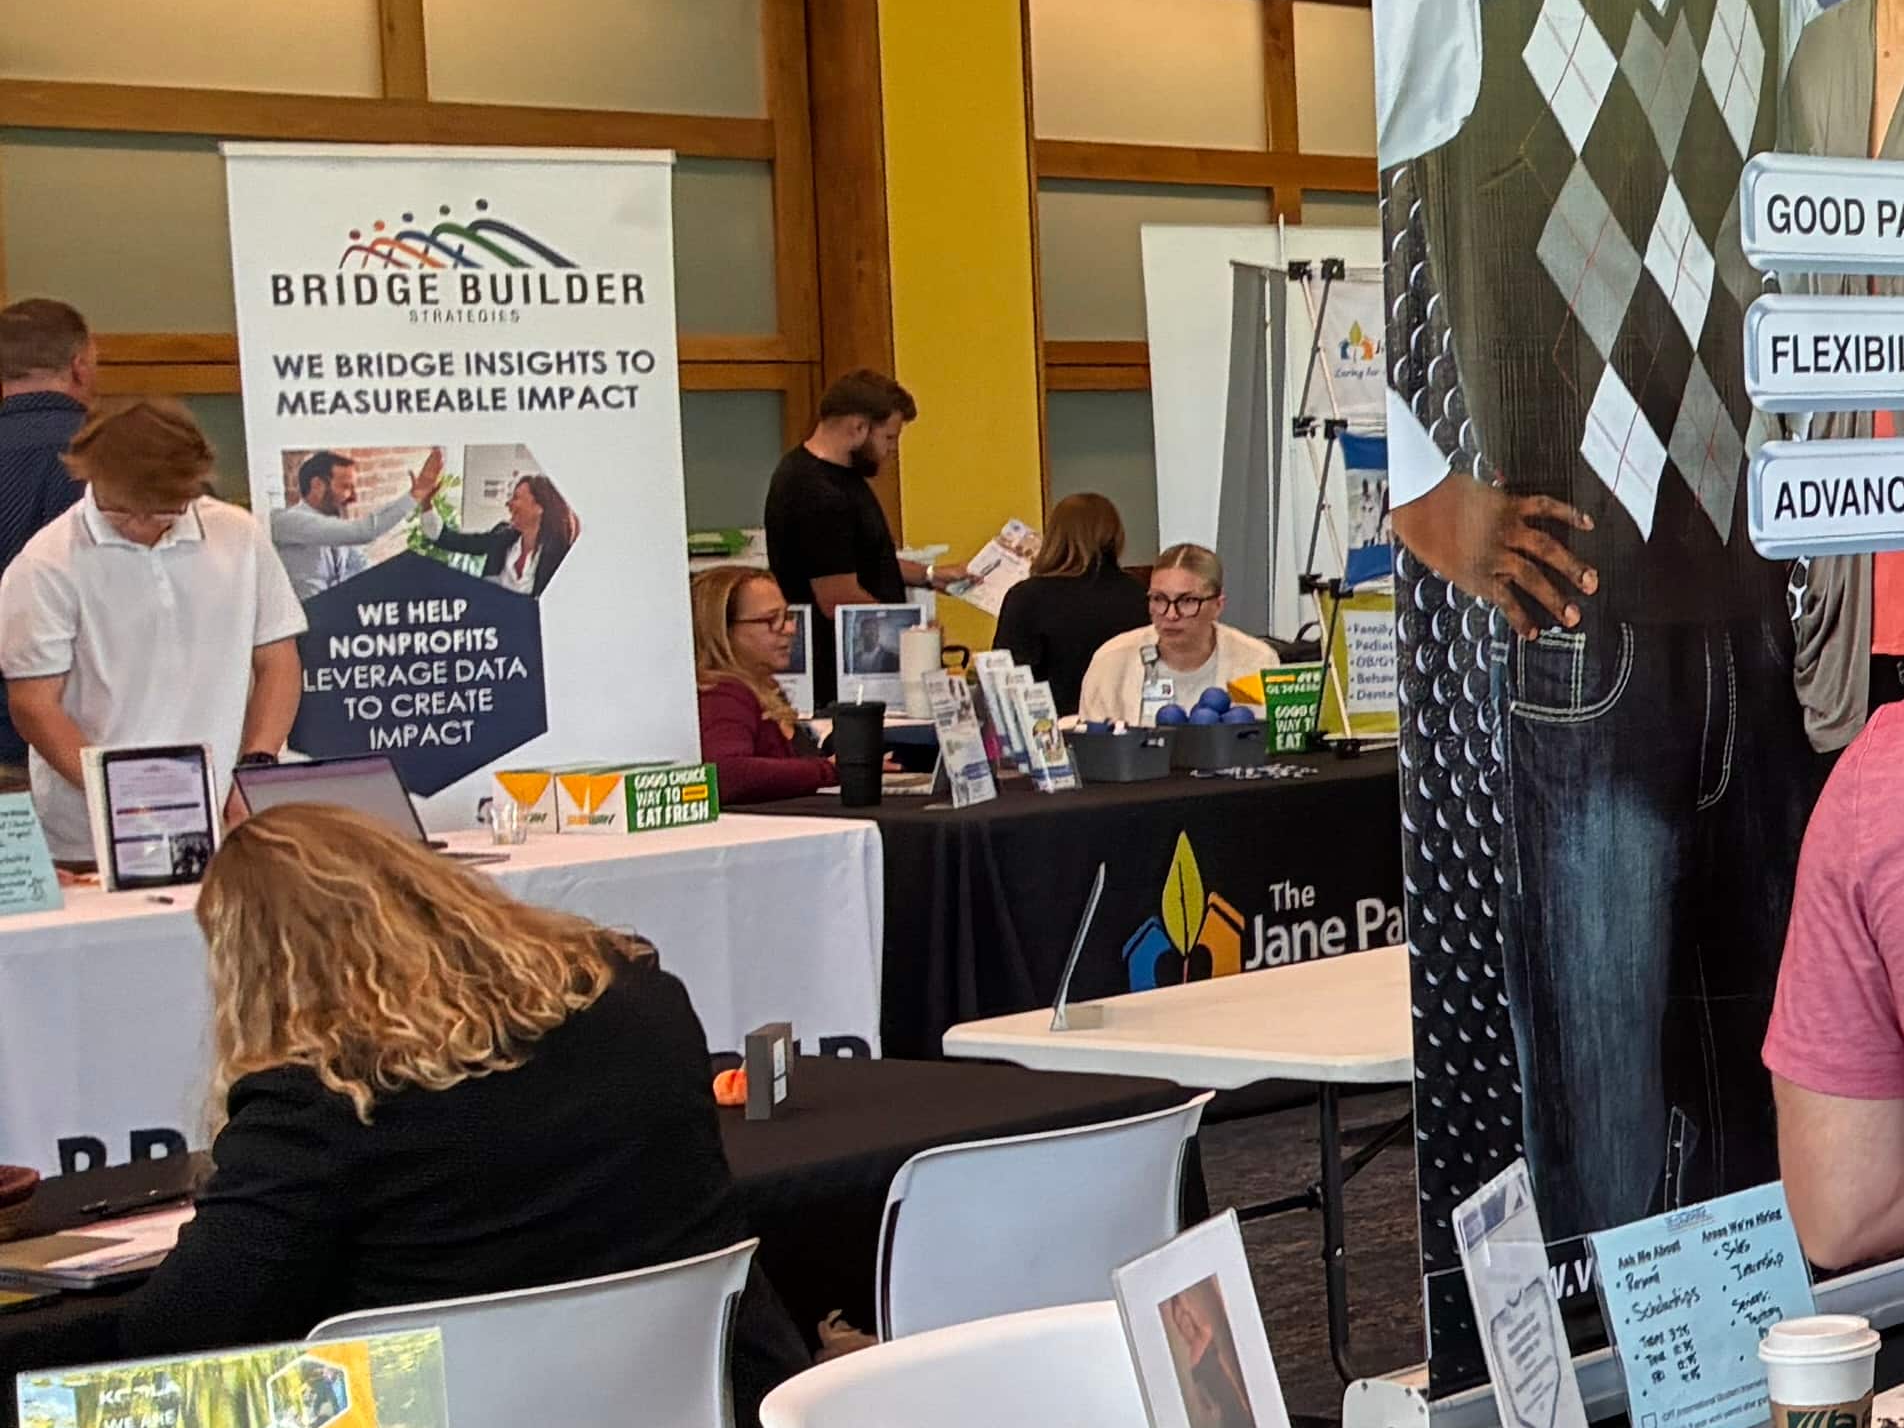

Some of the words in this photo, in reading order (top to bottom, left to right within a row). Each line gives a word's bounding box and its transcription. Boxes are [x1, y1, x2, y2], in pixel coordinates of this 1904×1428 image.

[1766, 193, 1866, 237] GOOD
[270, 272, 439, 307] BRIDGE
[460, 272, 646, 306] BUILDER
[272, 351, 324, 380] WE
[335, 351, 455, 379] BRIDGE
[464, 349, 608, 376] INSIGHTS
[615, 349, 656, 374] TO
[275, 386, 509, 418] MEASUREABLE
[517, 383, 640, 413] IMPACT
[356, 602, 400, 626] WE
[405, 598, 469, 625] HELP
[328, 628, 499, 659] NONPROFITS
[302, 661, 449, 693] LEVERAGE
[454, 656, 528, 685] DATA
[343, 695, 384, 721] TO
[389, 690, 494, 717] CREATE
[368, 720, 476, 752] IMPACT
[1275, 733, 1303, 751] EAT
[635, 788, 663, 808] WAY
[636, 809, 663, 830] EAT
[665, 800, 709, 822] FRESH
[1269, 879, 1316, 913] The
[1245, 914, 1347, 970] Jane
